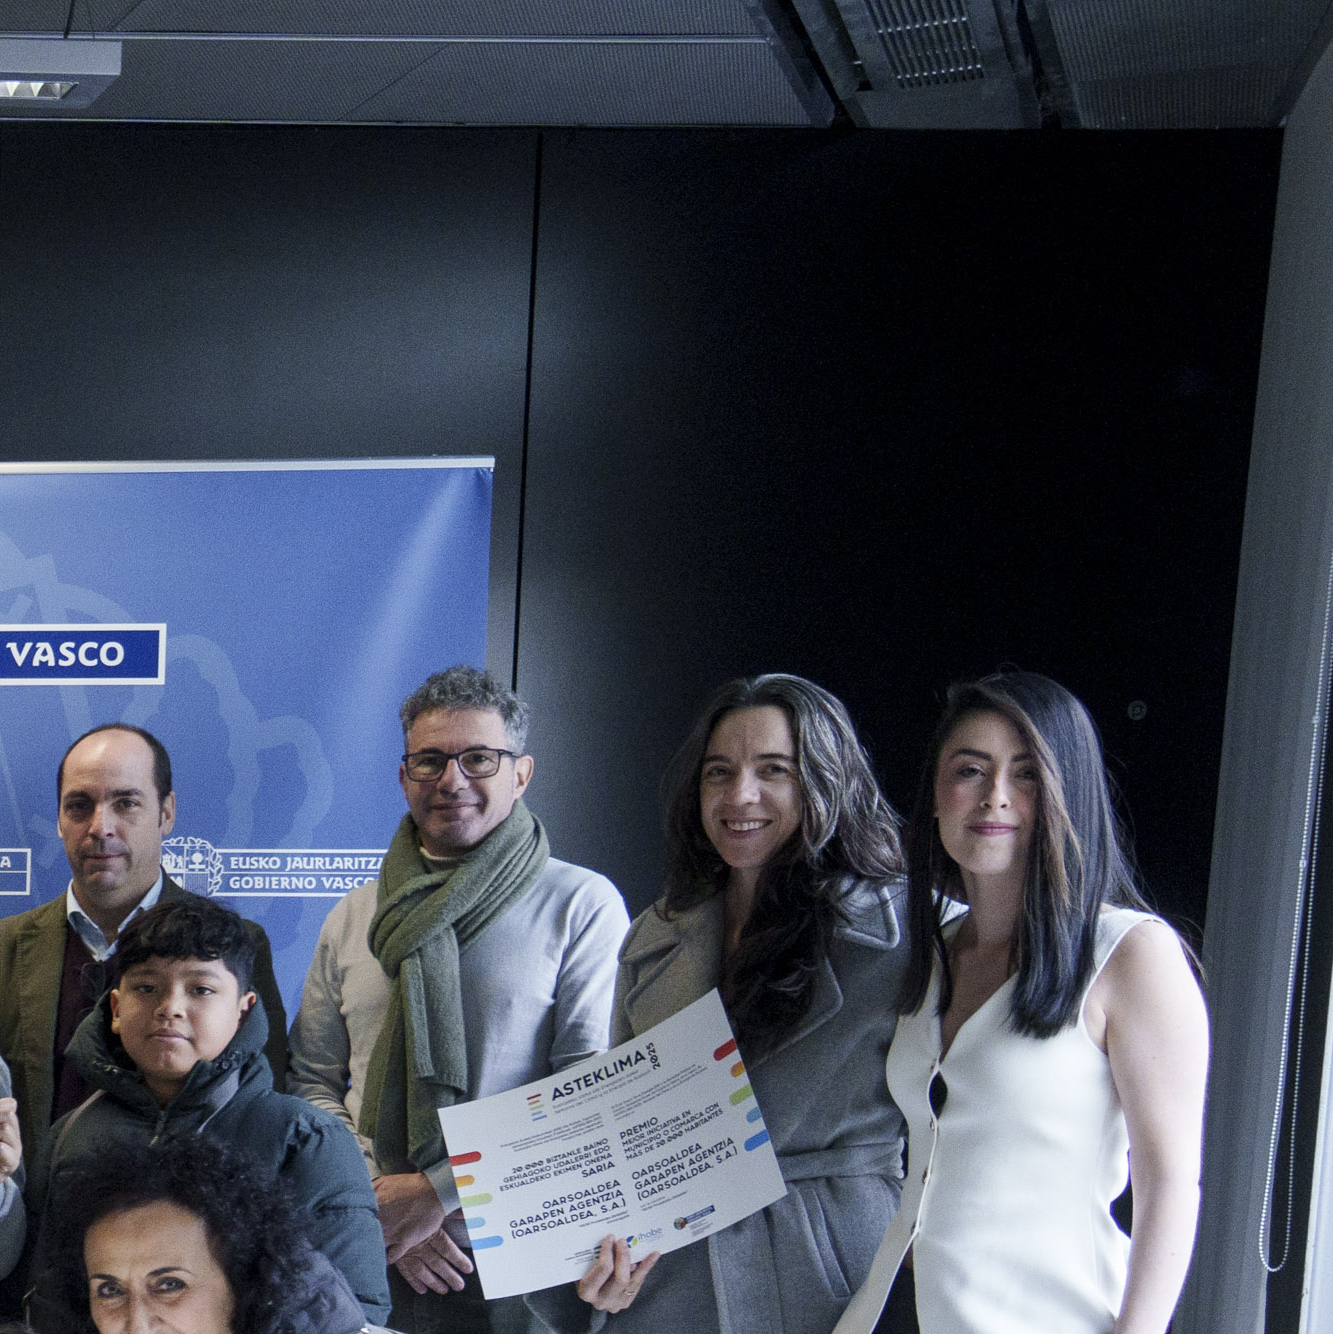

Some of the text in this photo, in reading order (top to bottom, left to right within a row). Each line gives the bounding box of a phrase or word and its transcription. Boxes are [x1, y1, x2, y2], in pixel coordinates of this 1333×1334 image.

[6, 641, 124, 667] VASCO
[230, 856, 281, 869] EUSKO
[229, 876, 316, 889] GOBIERNO
[552, 1050, 646, 1101] ASTEKLIMA
[646, 1042, 661, 1070] 2025
[619, 1117, 659, 1140] PREMIO
[622, 1109, 691, 1147] MEJOR INICIATIVA EN
[624, 1133, 661, 1154] MUNICIPIO
[670, 1111, 704, 1133] COMARCA
[705, 1102, 720, 1114] CON
[644, 1143, 654, 1153] DE
[684, 1108, 723, 1133] HABITANTES
[503, 1145, 610, 1183] GEHIAGOKO UDALERRI EDO
[546, 1148, 581, 1164] BIZTANLE
[583, 1138, 608, 1151] BAINO
[581, 1160, 615, 1178] SARIA
[631, 1142, 702, 1180] OARSOALDEA
[634, 1137, 734, 1190] GARAPEN AGENTZIA
[499, 1152, 613, 1192] ESKUALDEKO EKIMEN ONENA
[509, 1207, 564, 1228] GARAPEN
[569, 1189, 623, 1213] AGENTZIA
[542, 1179, 621, 1209] OARSOALDEA
[638, 1227, 663, 1240] ihobe
